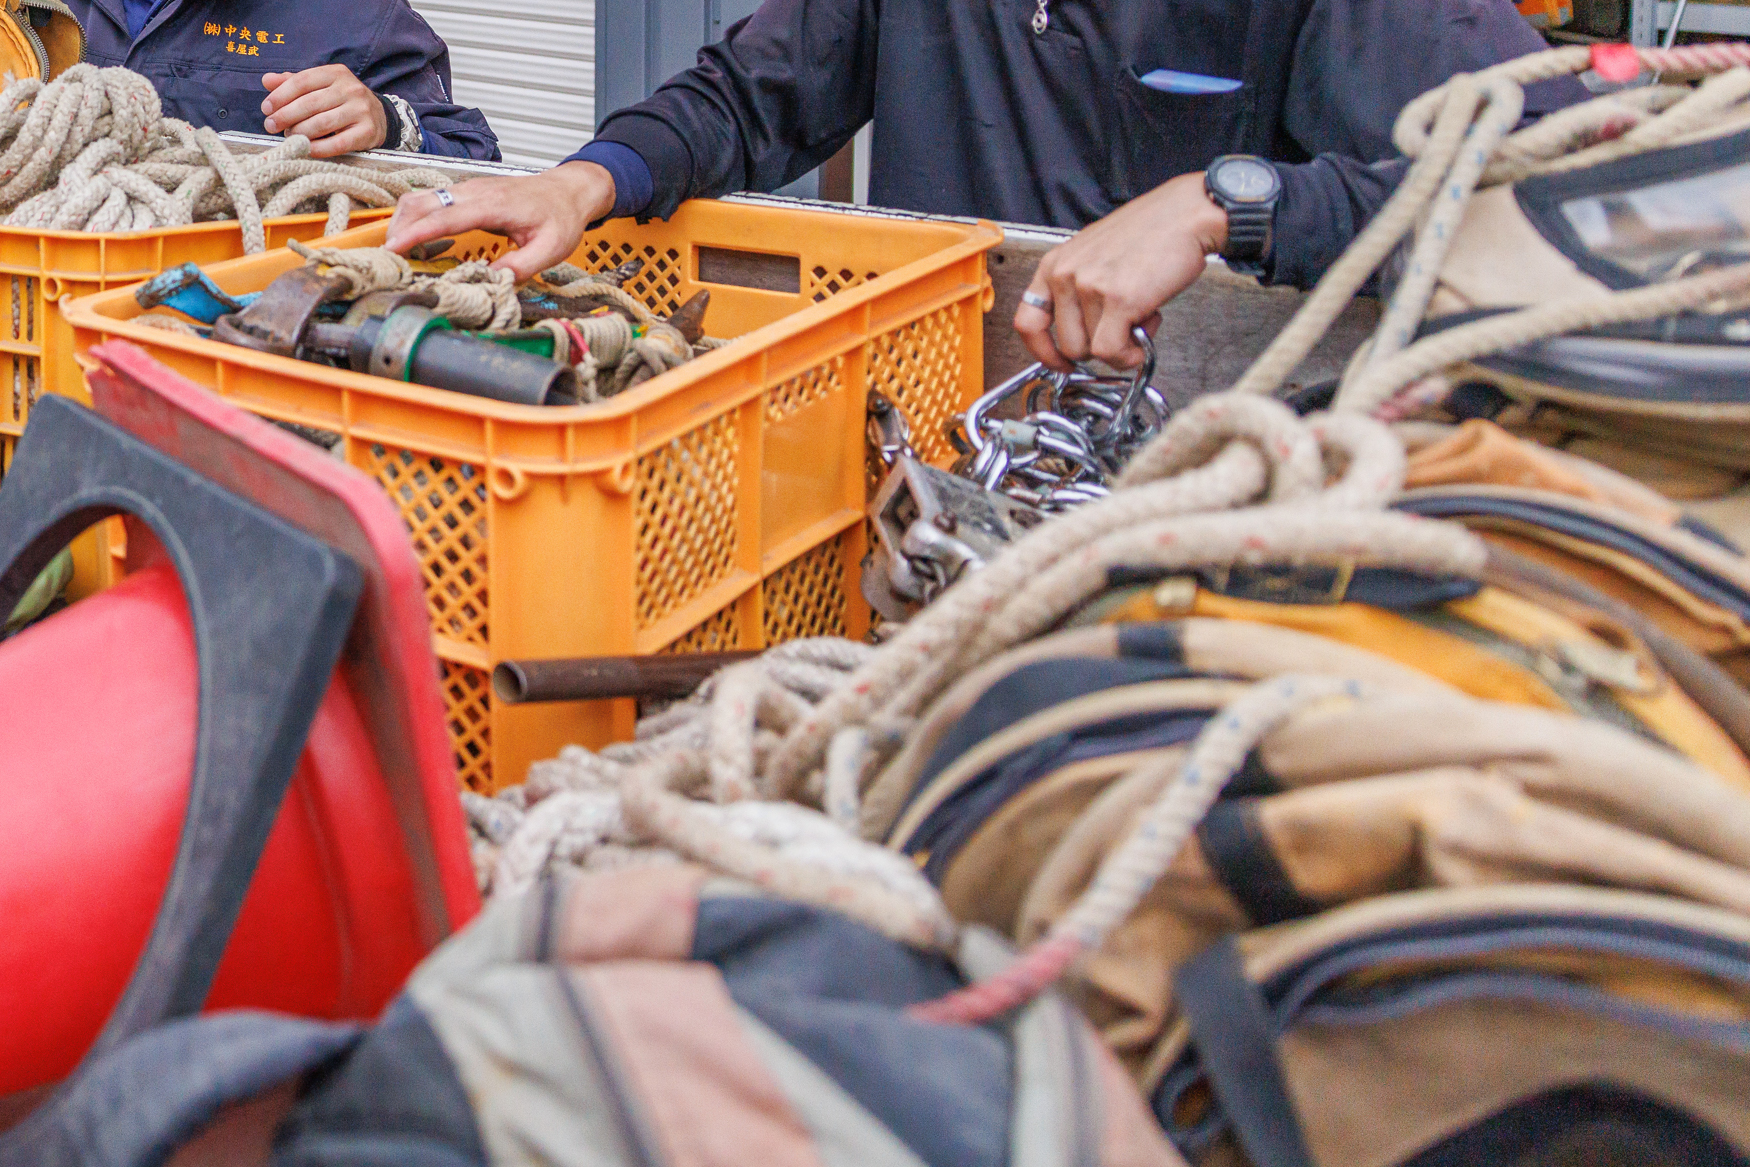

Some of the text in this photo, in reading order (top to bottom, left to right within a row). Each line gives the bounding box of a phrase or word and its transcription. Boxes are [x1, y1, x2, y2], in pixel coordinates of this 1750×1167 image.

[203, 21, 286, 44] (株)中央電工
